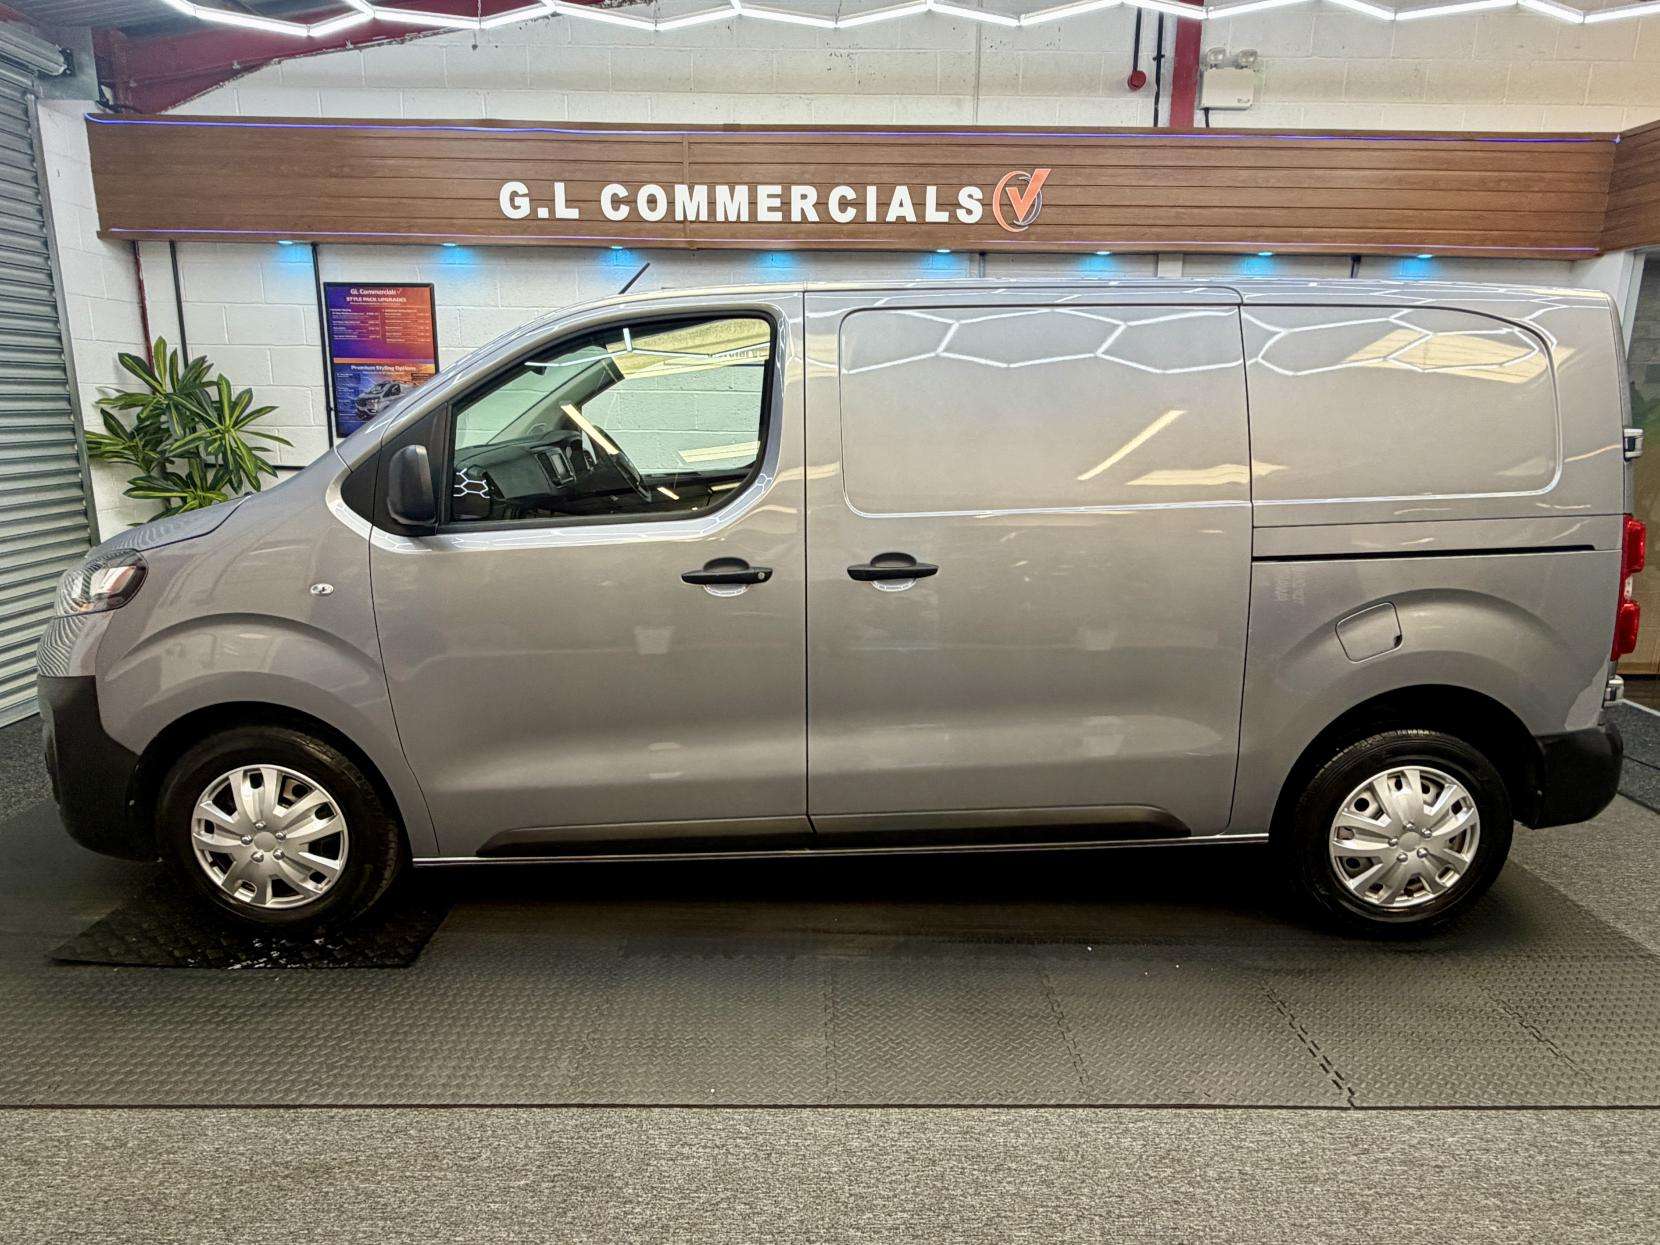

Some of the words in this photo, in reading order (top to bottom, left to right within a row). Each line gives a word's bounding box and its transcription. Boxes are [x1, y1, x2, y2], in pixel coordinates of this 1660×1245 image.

[499, 181, 580, 219] G.L
[600, 183, 983, 224] COMMERCIALS
[376, 365, 394, 373] Styling
